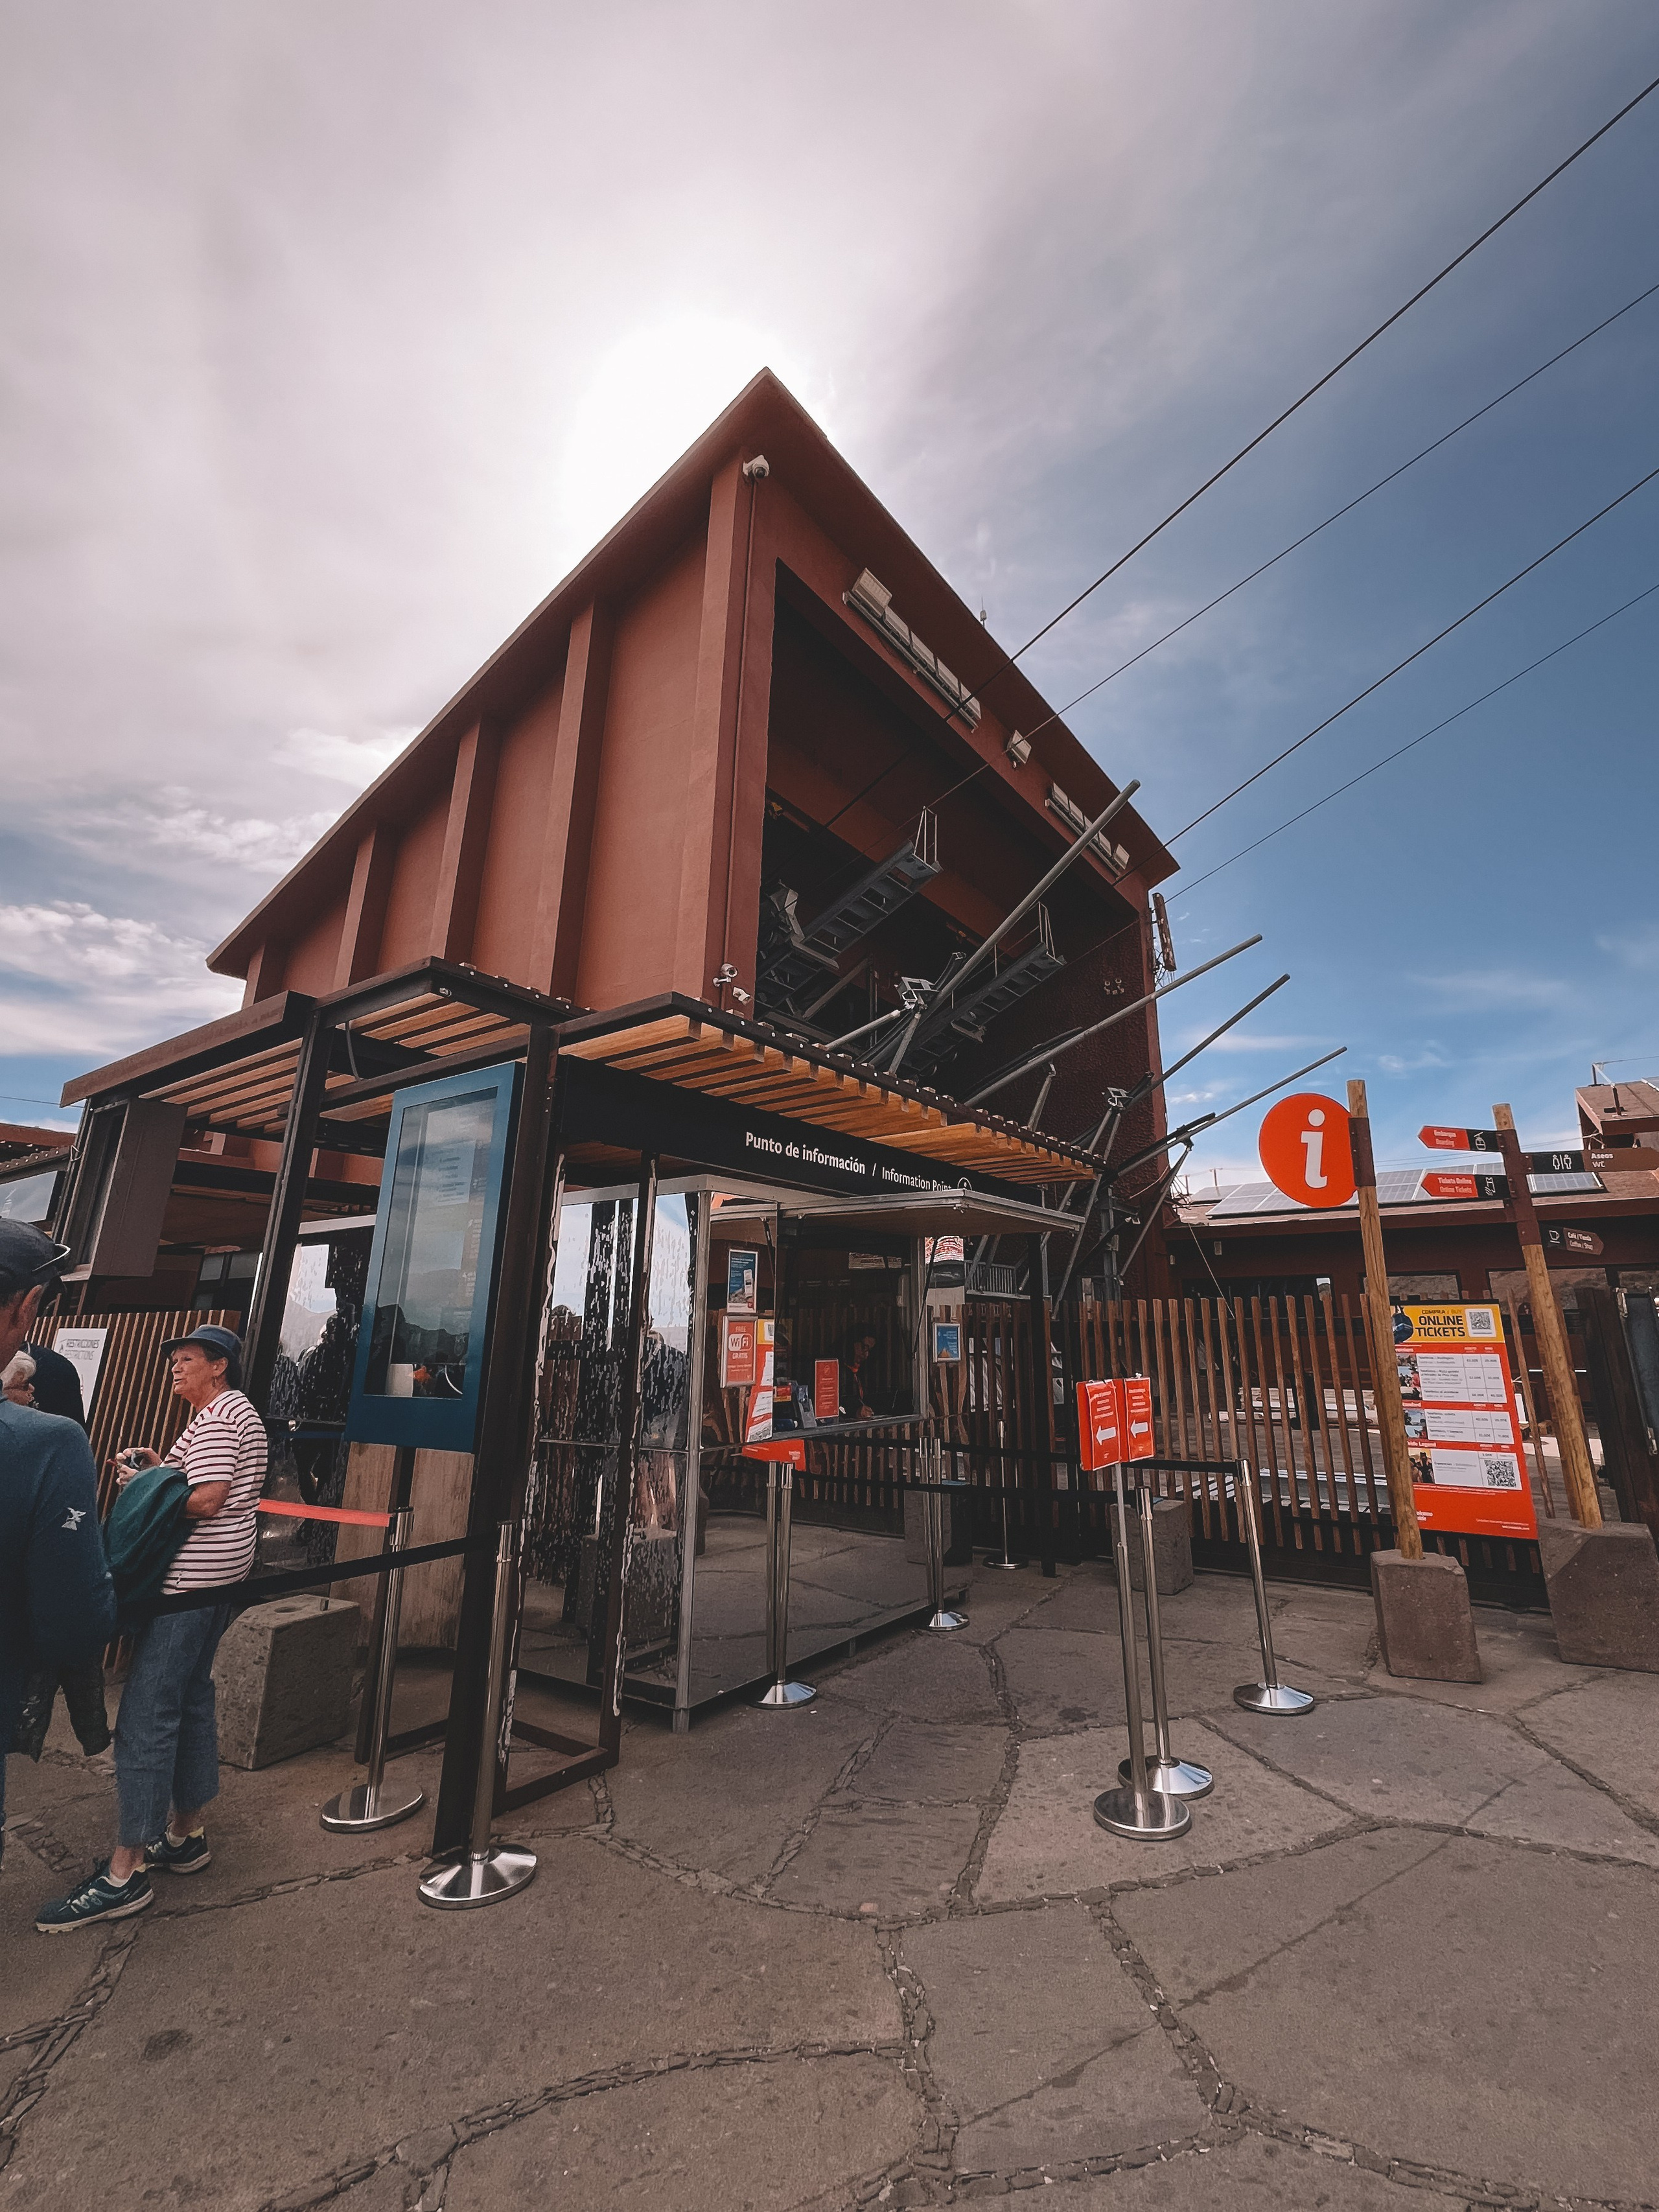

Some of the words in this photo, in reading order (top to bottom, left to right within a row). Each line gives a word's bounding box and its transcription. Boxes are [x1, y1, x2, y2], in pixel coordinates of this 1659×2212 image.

[745, 1131, 782, 1154] Punto
[785, 1141, 800, 1158] de
[802, 1144, 865, 1174] información
[872, 1163, 877, 1177] /
[882, 1167, 931, 1191] Information
[1419, 1315, 1464, 1326] ONLINE
[1415, 1327, 1466, 1337] TICKETS
